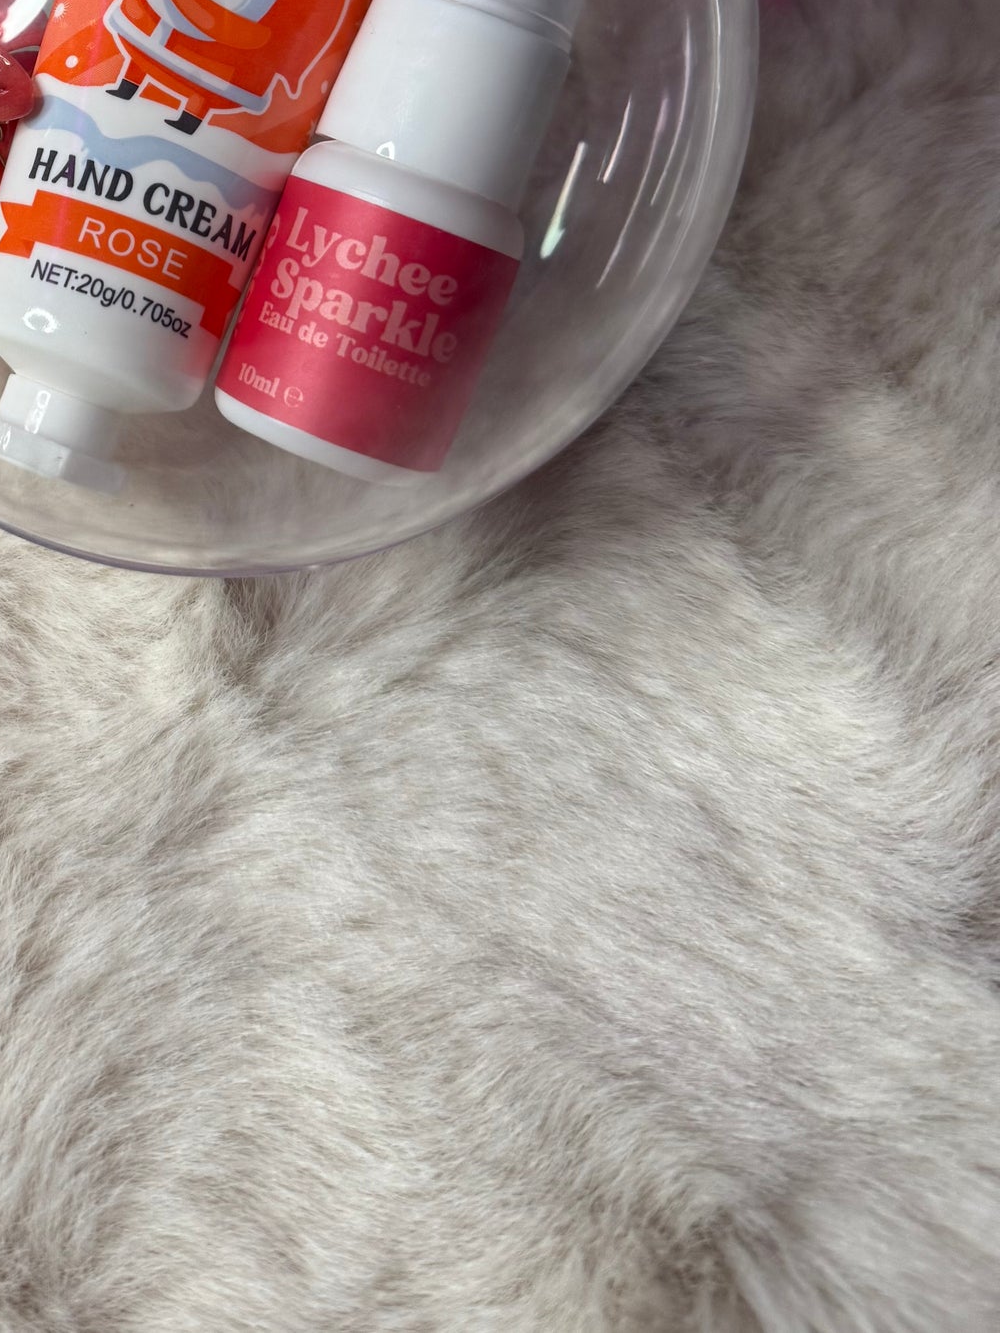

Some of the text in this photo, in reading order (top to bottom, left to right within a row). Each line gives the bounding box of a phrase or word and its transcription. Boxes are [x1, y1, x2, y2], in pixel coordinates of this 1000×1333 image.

[28, 147, 257, 263] HAND CREAM
[77, 216, 188, 281] ROSE
[30, 259, 193, 339] NET:20g/0.705oz
[285, 206, 459, 306] Lychee
[258, 300, 433, 388] Eau de Toilette
[270, 257, 459, 363] Sparkle
[237, 362, 280, 399] 10ml
